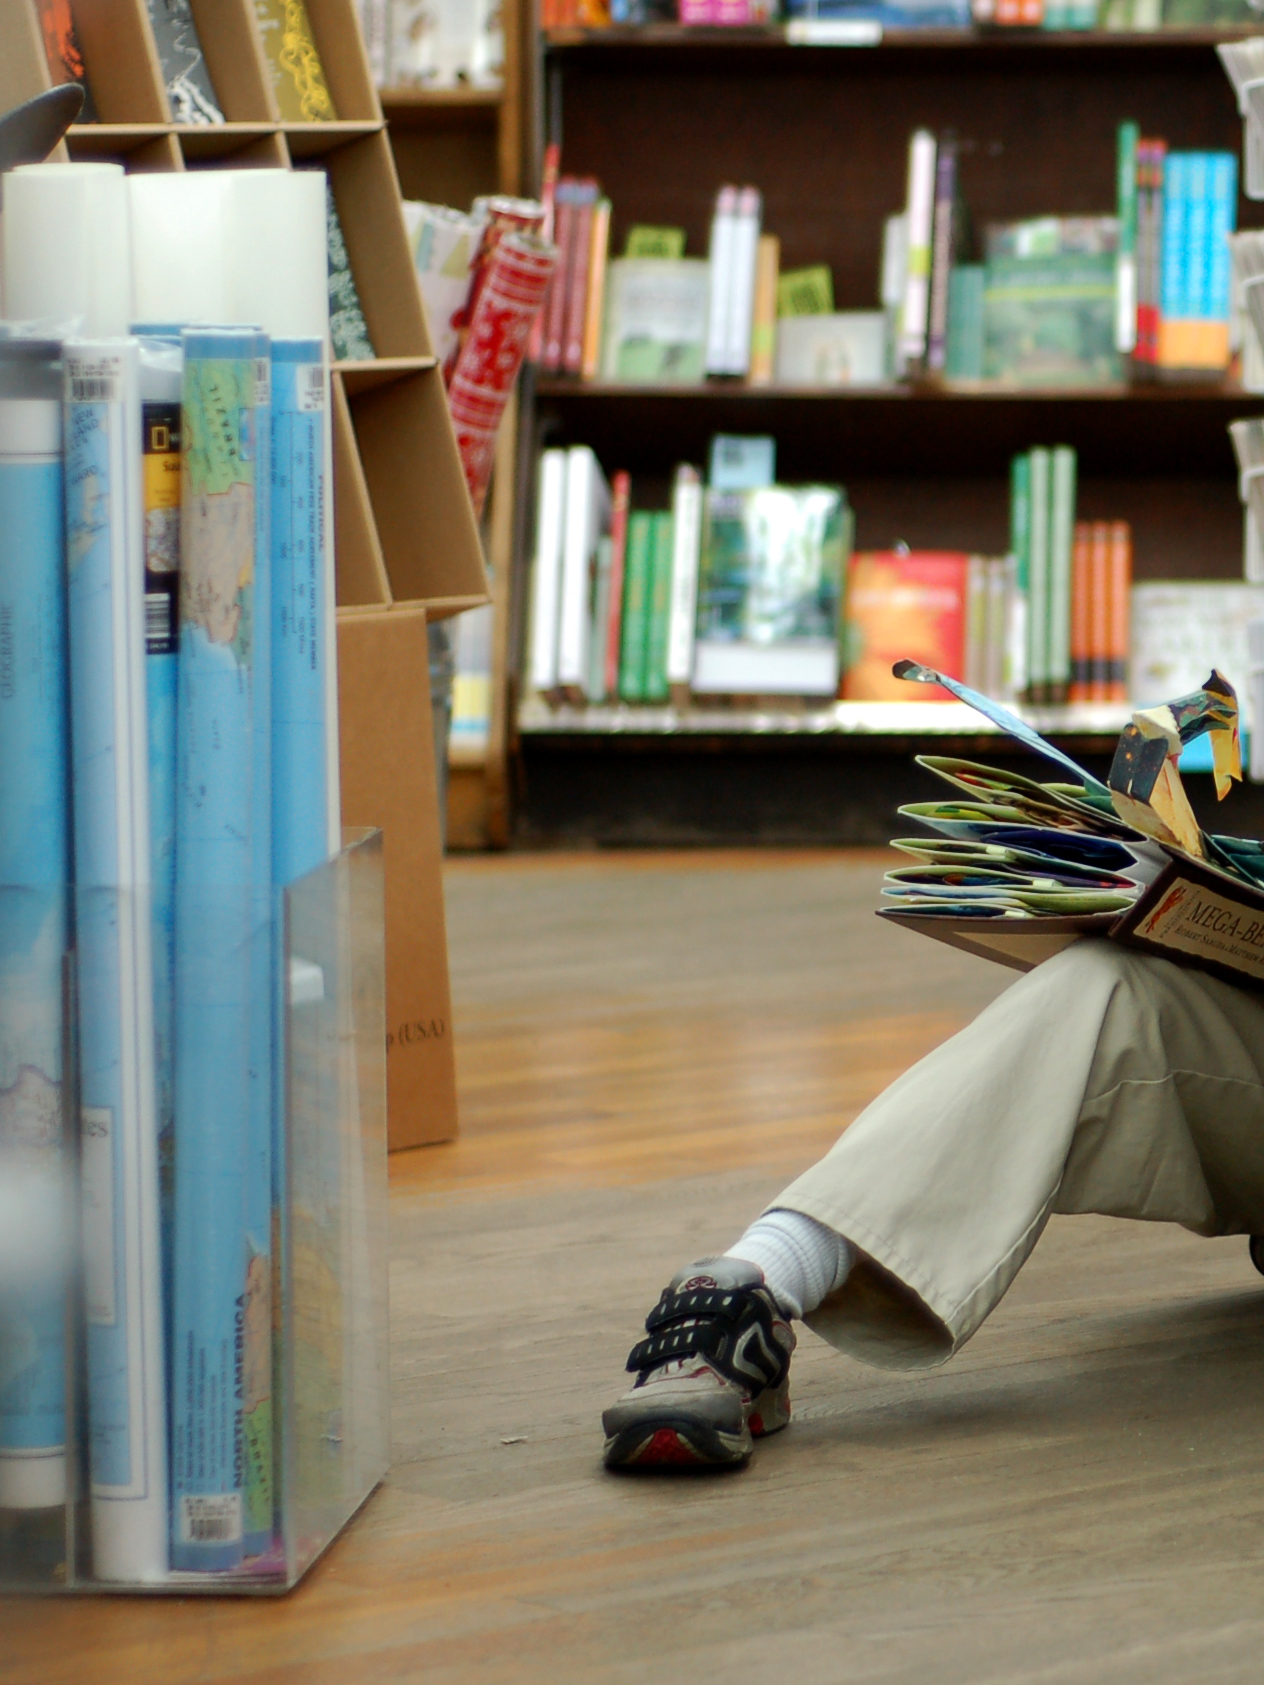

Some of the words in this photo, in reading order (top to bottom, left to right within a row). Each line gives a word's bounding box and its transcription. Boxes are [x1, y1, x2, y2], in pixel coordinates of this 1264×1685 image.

[398, 1018, 445, 1049] (USA)
[233, 1293, 245, 1401] AMERICA
[233, 1409, 243, 1488] NORTH
